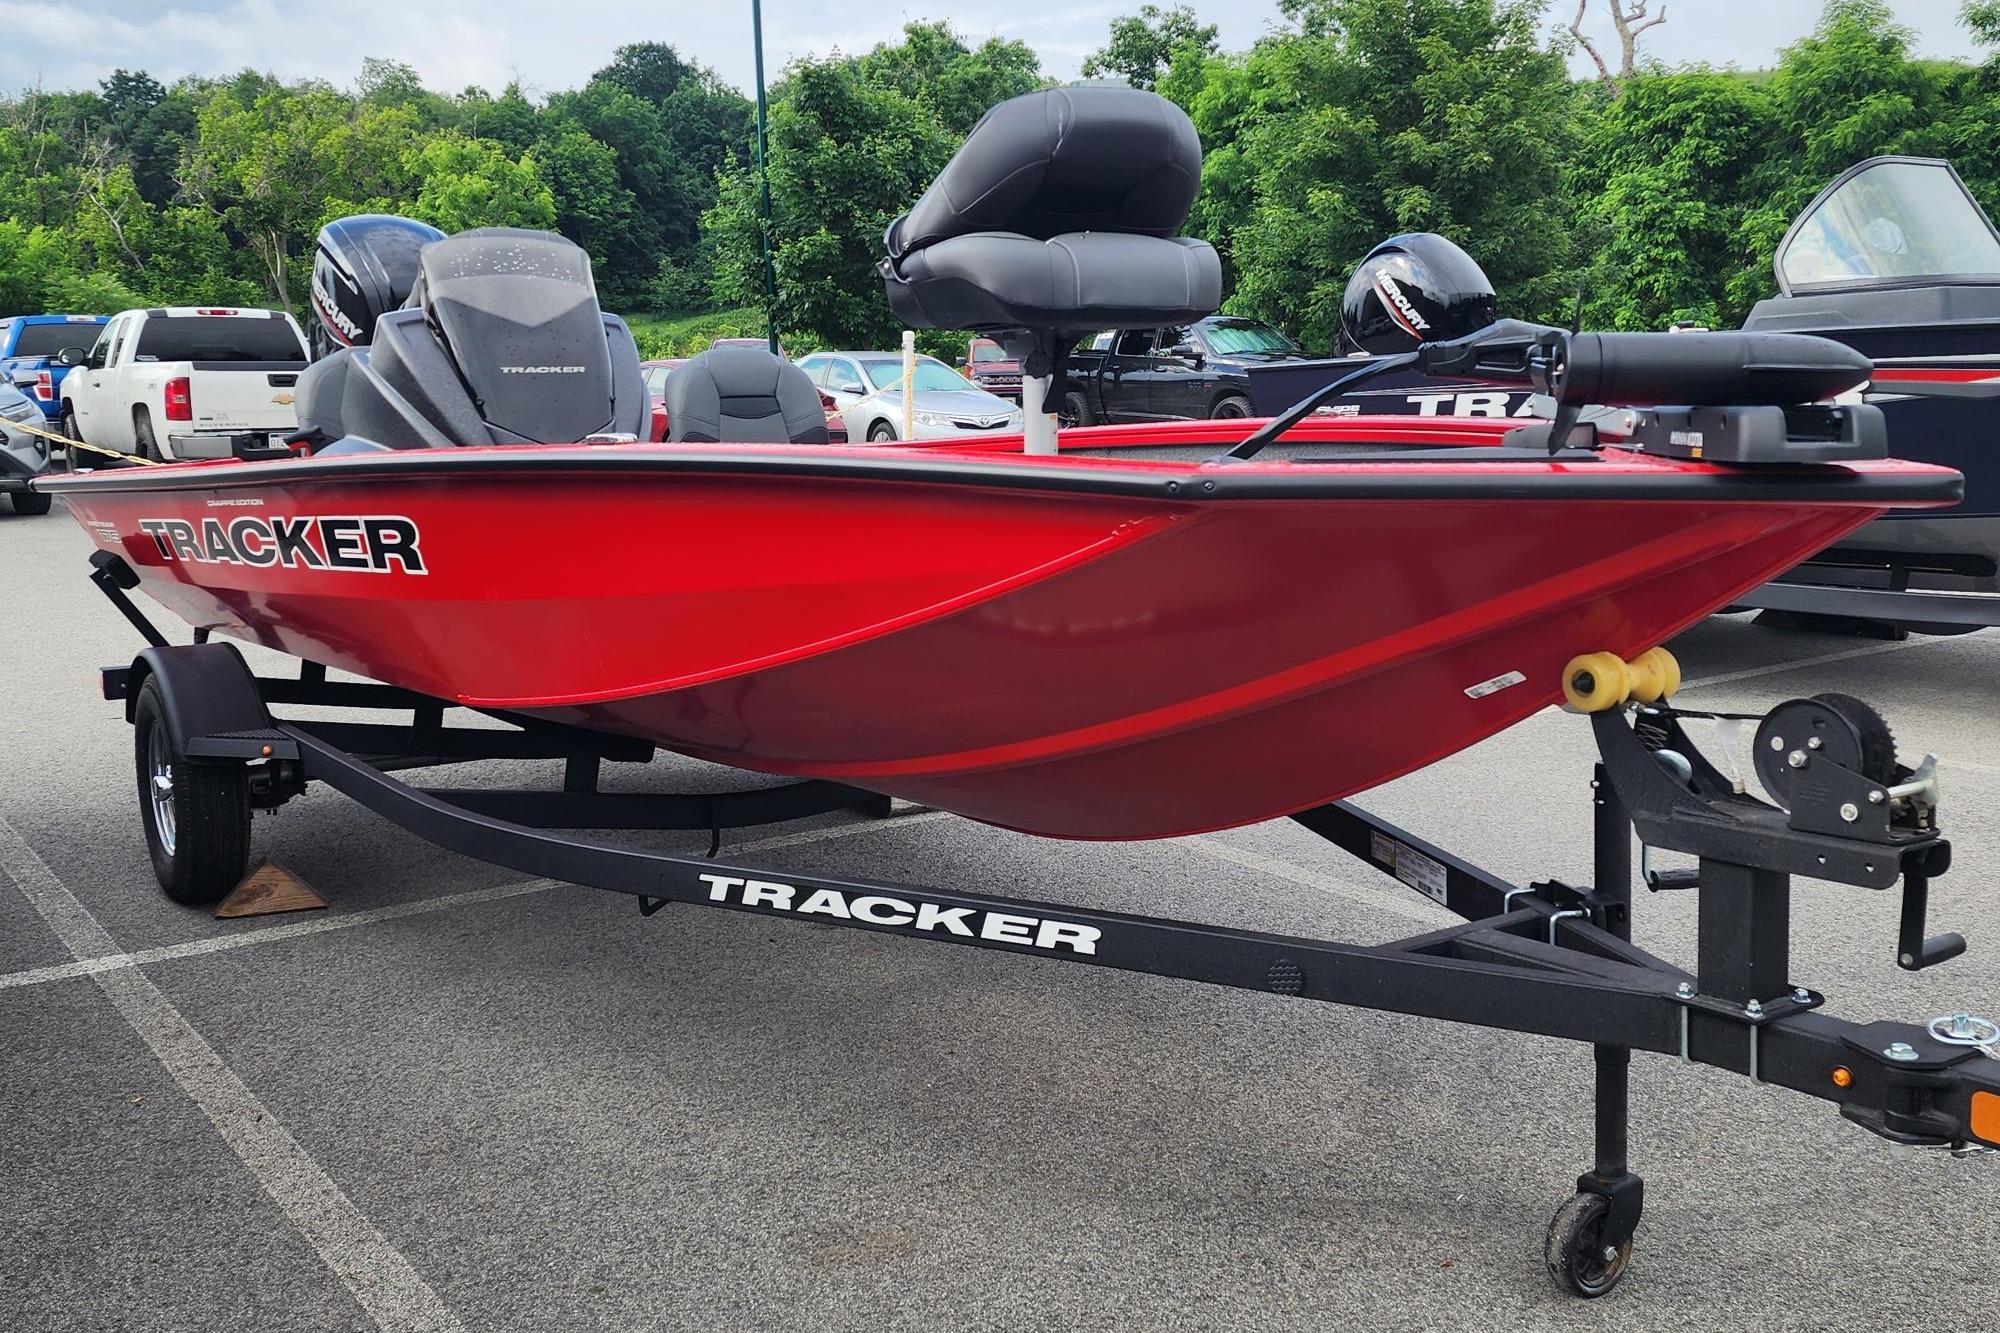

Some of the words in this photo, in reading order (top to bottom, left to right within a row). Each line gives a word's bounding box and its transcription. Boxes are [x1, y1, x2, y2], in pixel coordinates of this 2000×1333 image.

[1375, 268, 1431, 330] MERCURY
[500, 366, 585, 374] TRACKER
[138, 516, 429, 576] TRACKER
[699, 873, 1103, 955] TRACKER
